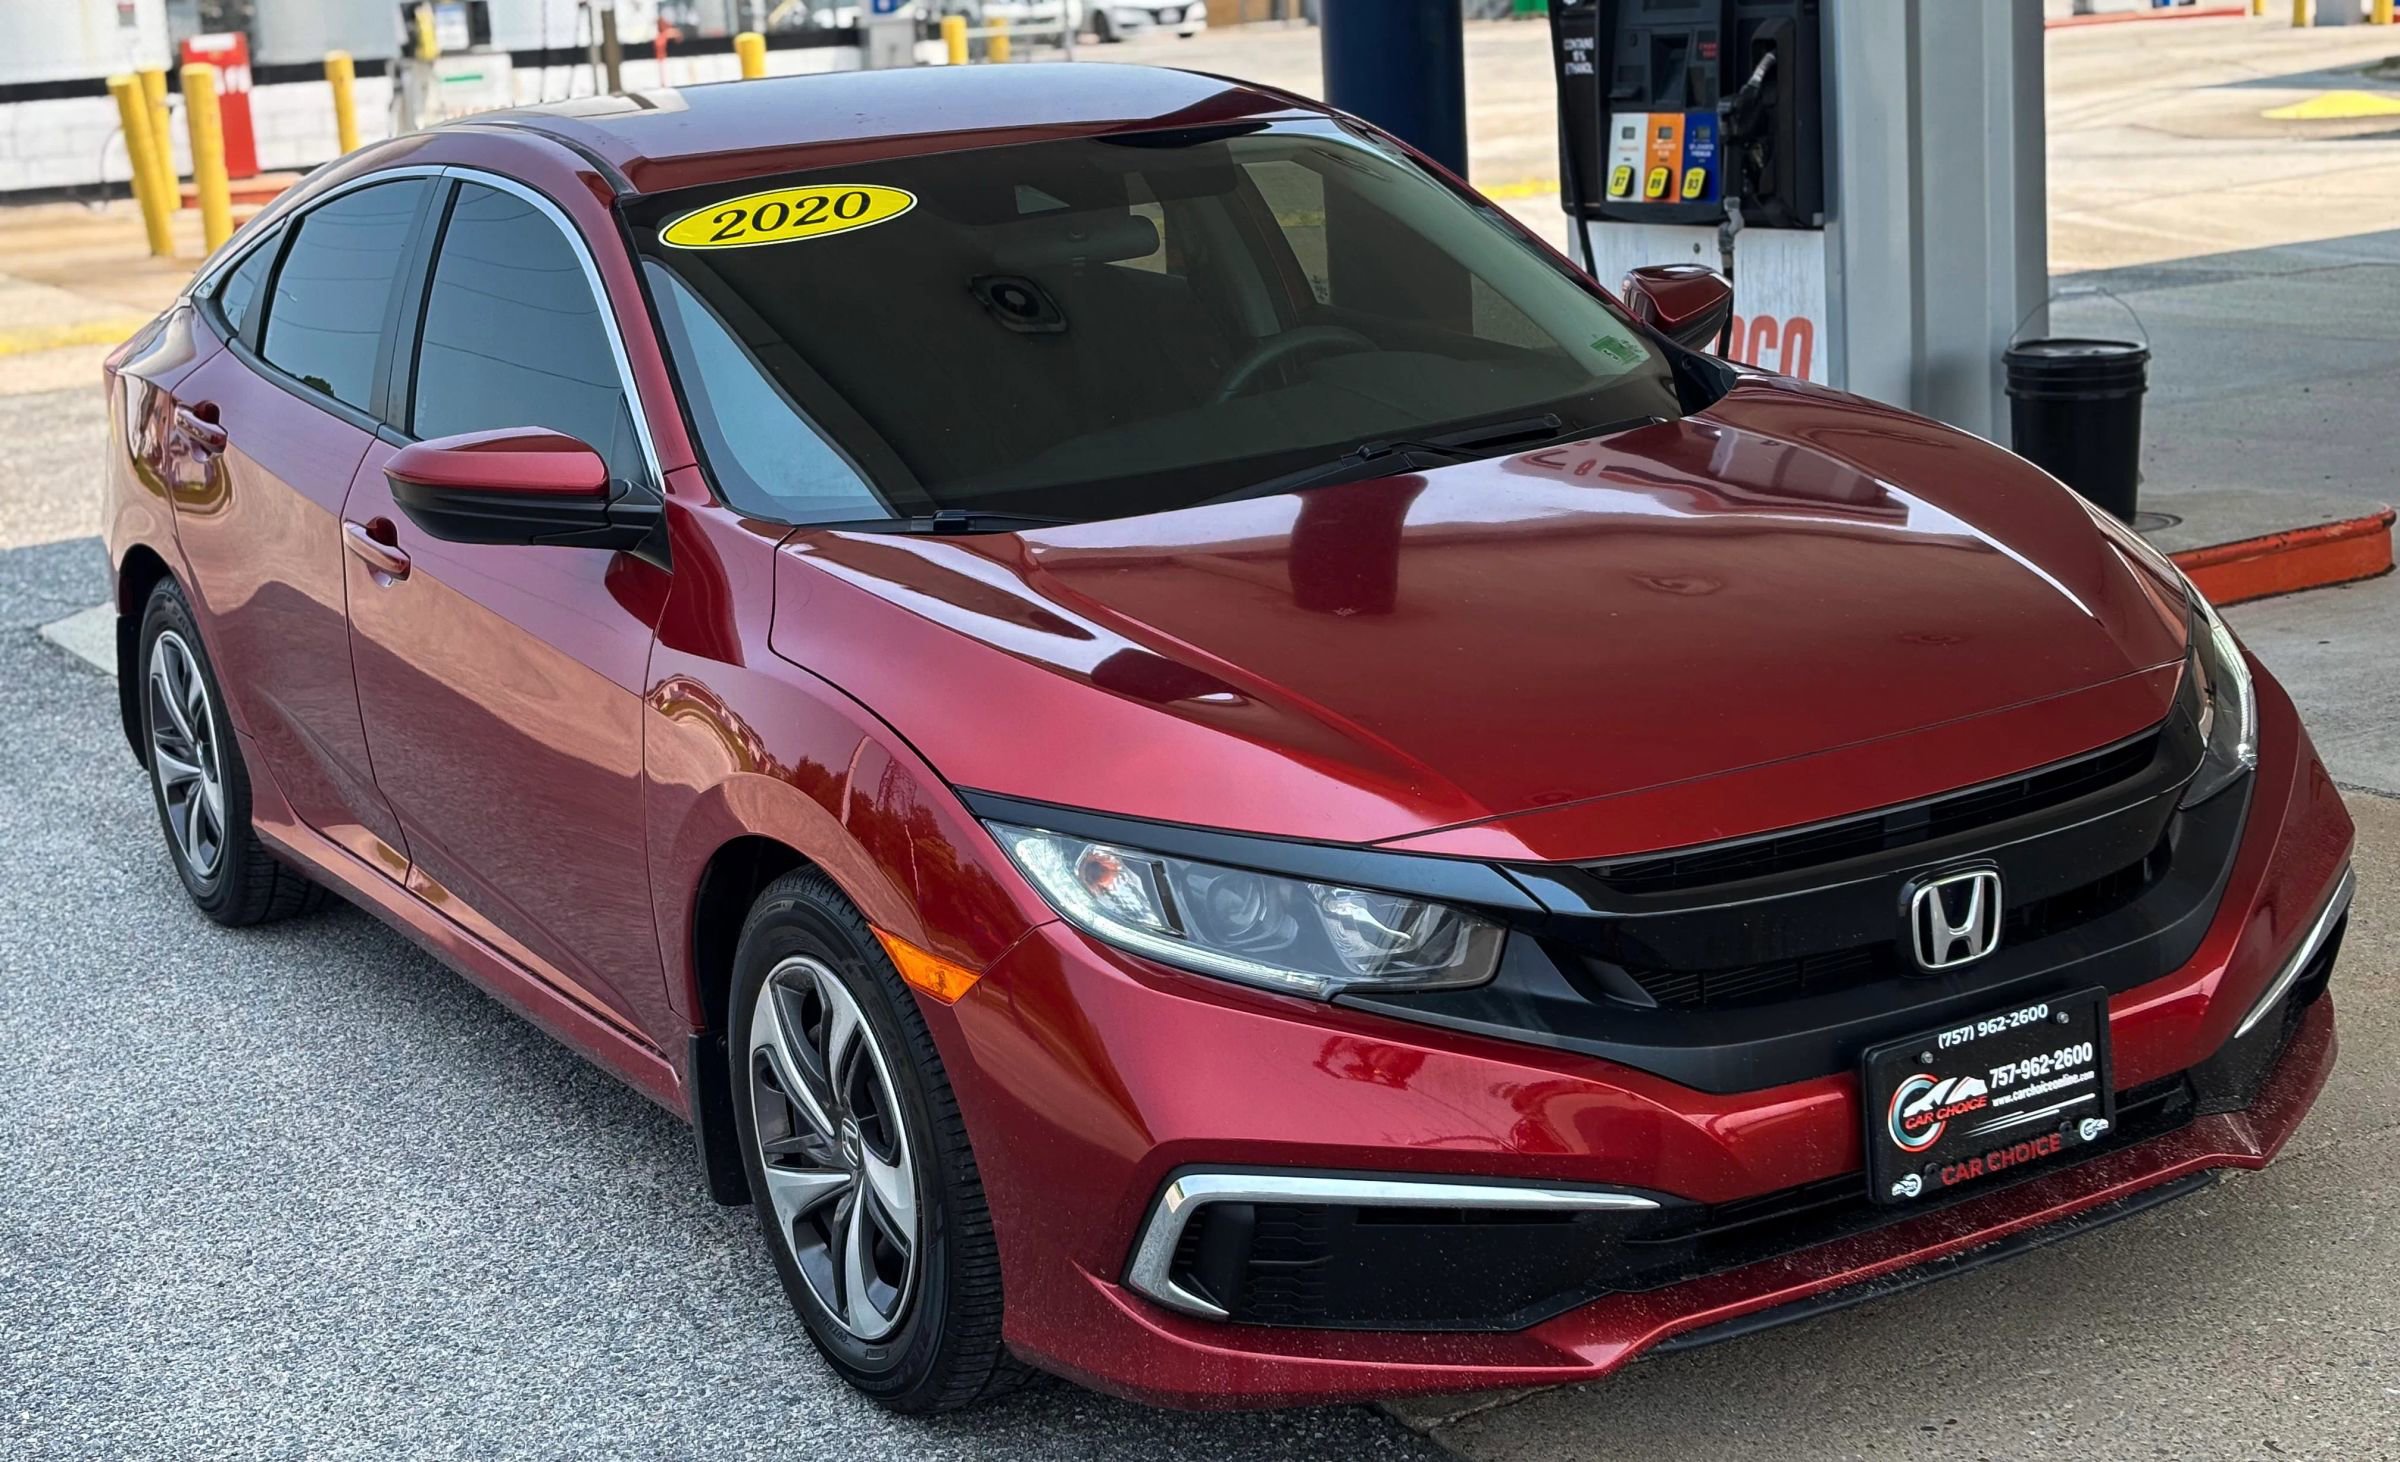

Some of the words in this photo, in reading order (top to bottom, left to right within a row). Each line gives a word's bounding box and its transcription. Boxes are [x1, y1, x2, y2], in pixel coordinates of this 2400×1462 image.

[709, 191, 872, 242] 2020
[1937, 1024, 1975, 1050] (757)
[1977, 1003, 2049, 1038] 962-2600
[1989, 1041, 2094, 1089] 757-962-2600
[1904, 1111, 1935, 1130] CAR
[1936, 1095, 1988, 1120] CHOICE
[1941, 1156, 1984, 1186] CAR
[1987, 1132, 2062, 1172] CHOICE
